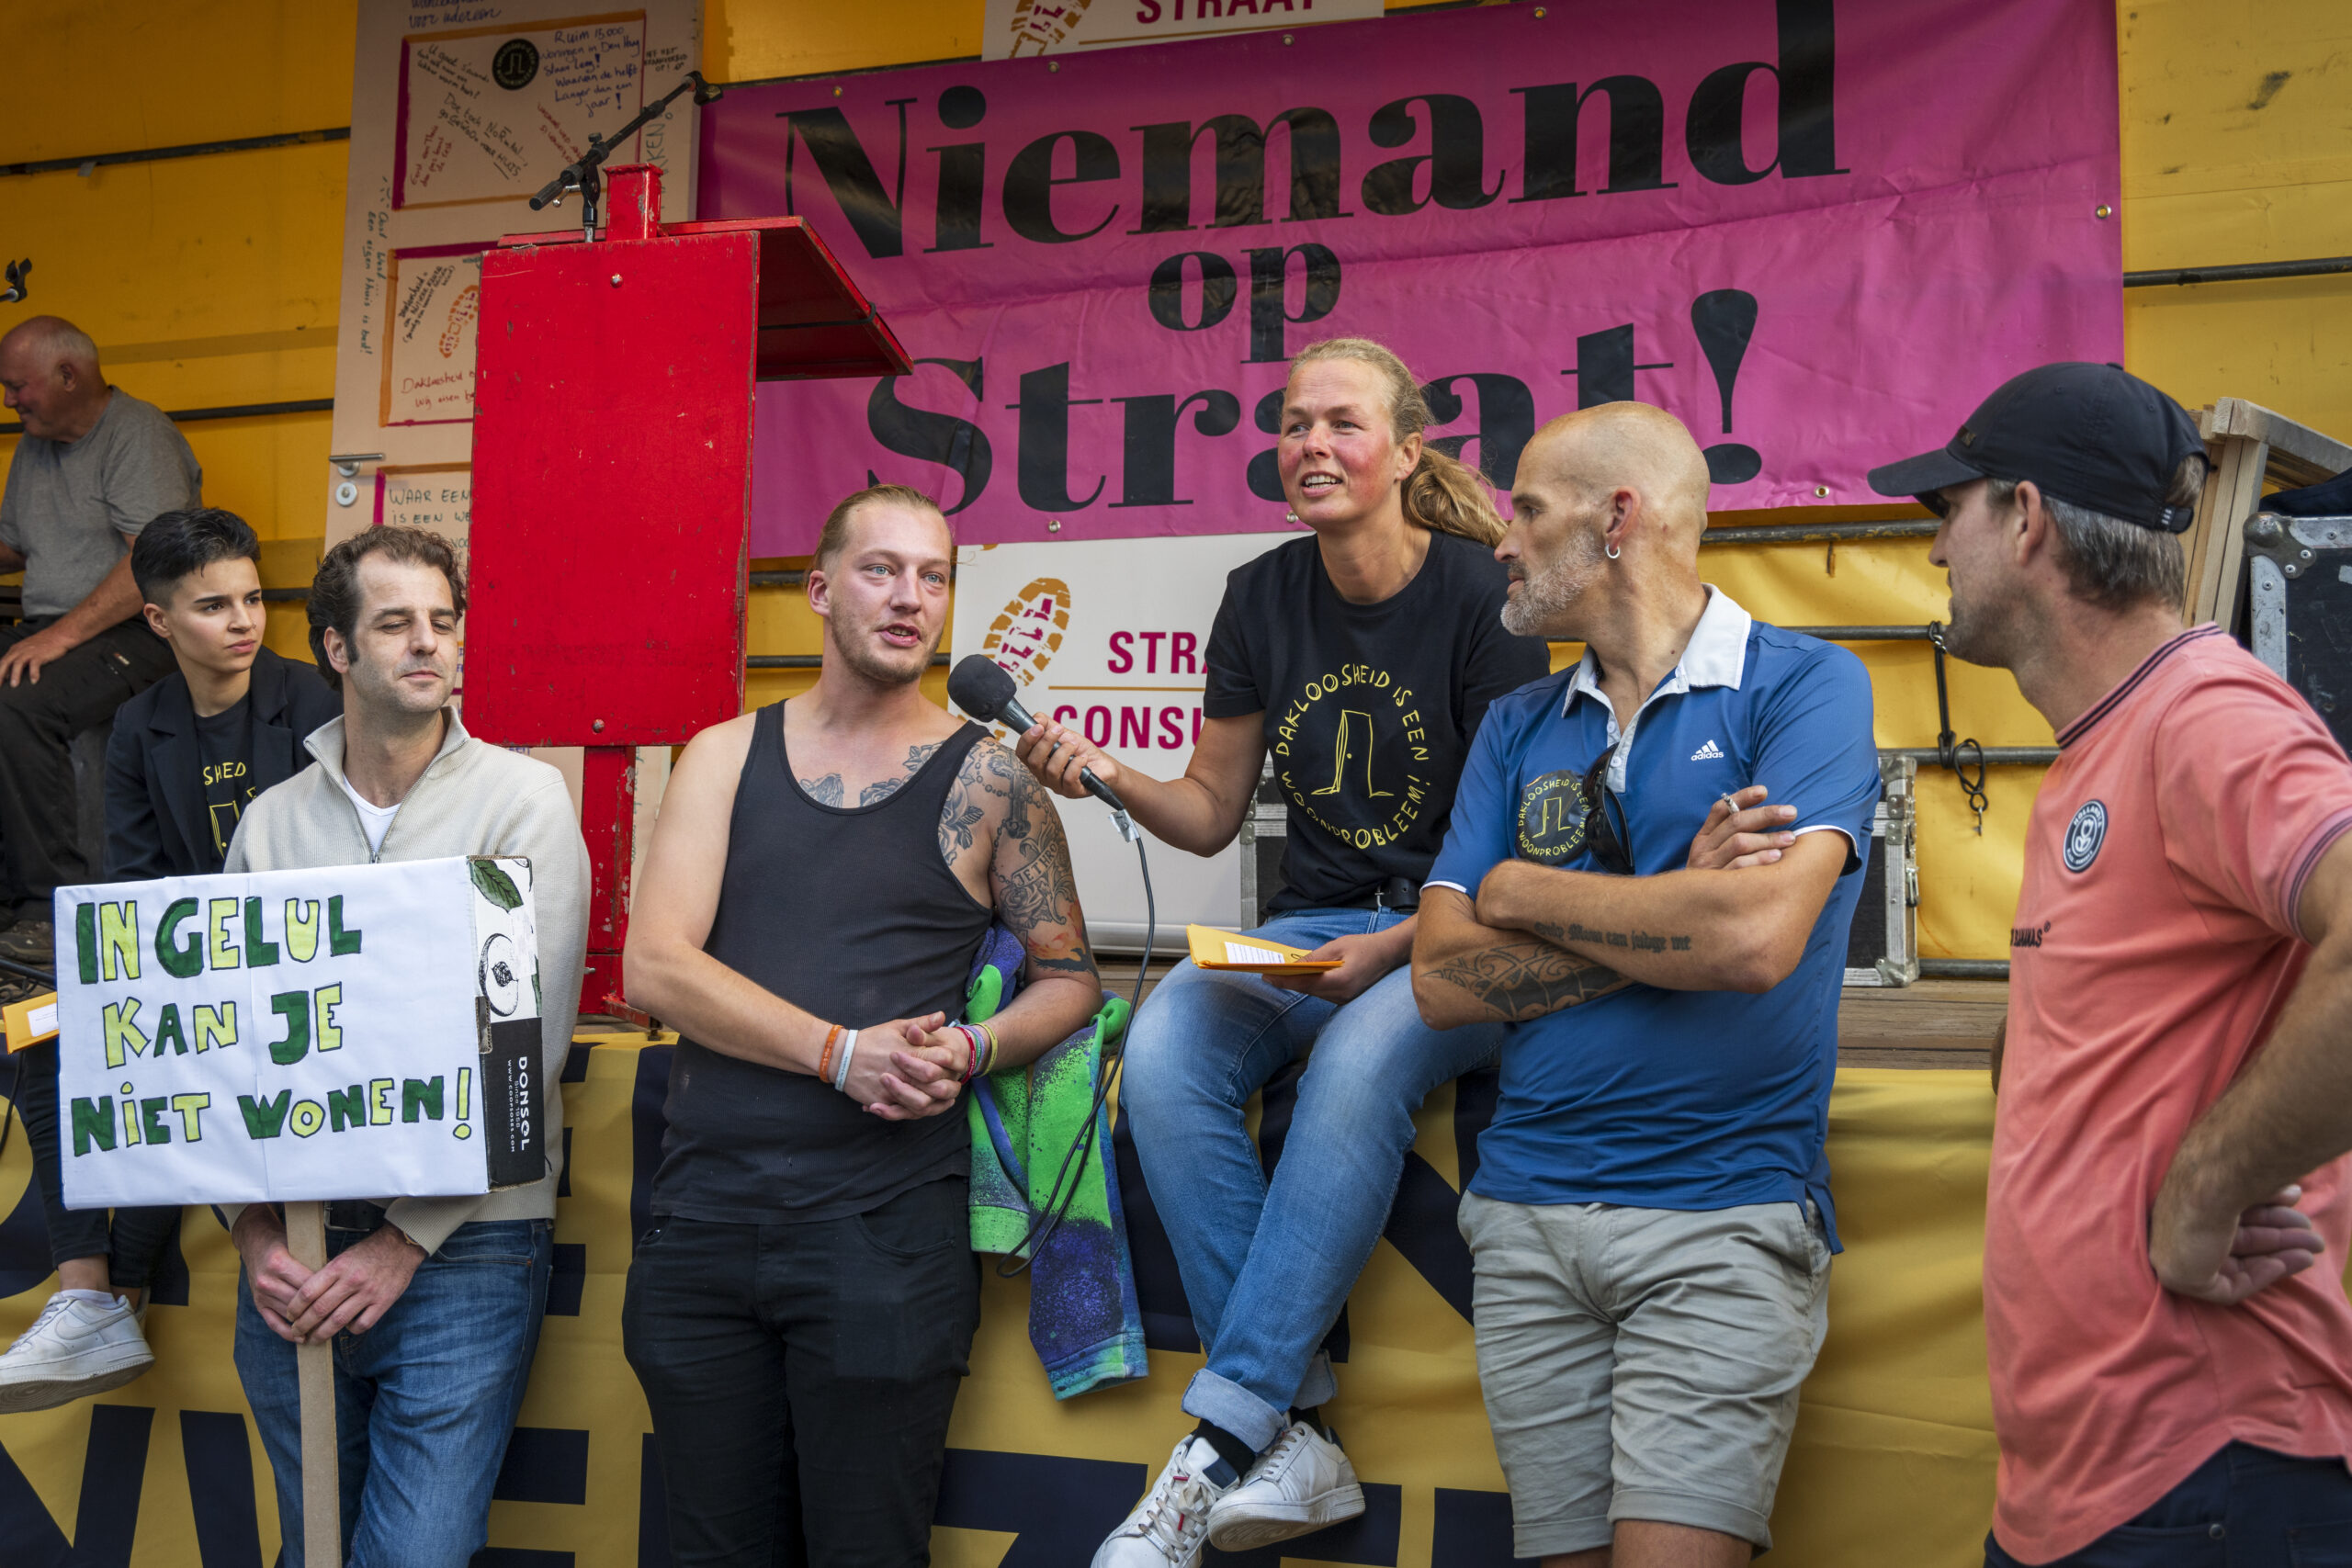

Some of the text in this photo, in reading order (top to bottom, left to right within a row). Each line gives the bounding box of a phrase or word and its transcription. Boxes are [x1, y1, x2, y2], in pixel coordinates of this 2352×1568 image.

[1136, 0, 1313, 24] STR
[600, 41, 621, 53] Den
[600, 71, 613, 81] de
[775, 0, 1850, 259] Niemand
[362, 240, 373, 270] eigen
[1148, 243, 1341, 365] op
[389, 488, 470, 505] WAAR EEN
[413, 513, 443, 525] EEN
[1107, 631, 1207, 674] STR
[1275, 663, 1391, 757] DAKLOOSHEID
[1392, 686, 1413, 708] IS
[1052, 705, 1202, 750] ONS
[1402, 709, 1430, 761] EEN
[1690, 750, 1724, 761] adidas
[1518, 778, 1570, 827] DAKLOOSHEID
[1570, 782, 1581, 792] IS
[1576, 790, 1590, 812] EEN
[1013, 843, 1057, 886] JETHRO
[75, 894, 362, 985] IN GELUL
[1606, 931, 1628, 948] can
[1631, 930, 1667, 953] judge
[1670, 935, 1691, 952] me
[102, 981, 343, 1070] KAN JE
[236, 1066, 472, 1141] WONEN!
[518, 1056, 530, 1151] DONSOL
